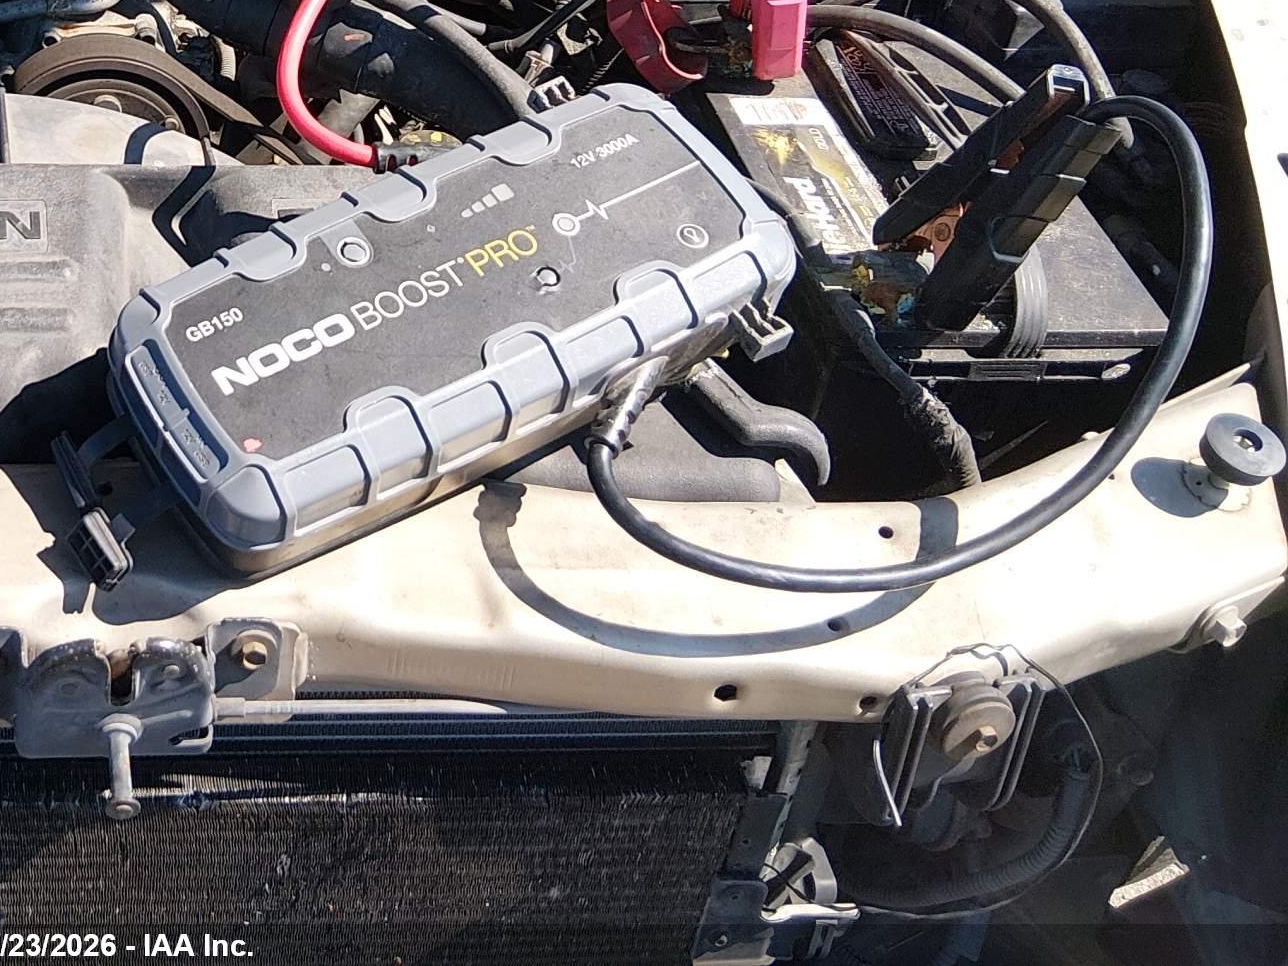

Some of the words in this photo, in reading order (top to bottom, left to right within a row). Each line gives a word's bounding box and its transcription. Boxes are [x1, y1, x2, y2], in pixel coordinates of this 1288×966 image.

[570, 150, 596, 170] 12V
[596, 132, 640, 160] 3000A
[184, 306, 244, 343] GB150
[211, 312, 356, 396] NOCO
[349, 256, 465, 332] BOOST
[464, 228, 539, 278] PRO
